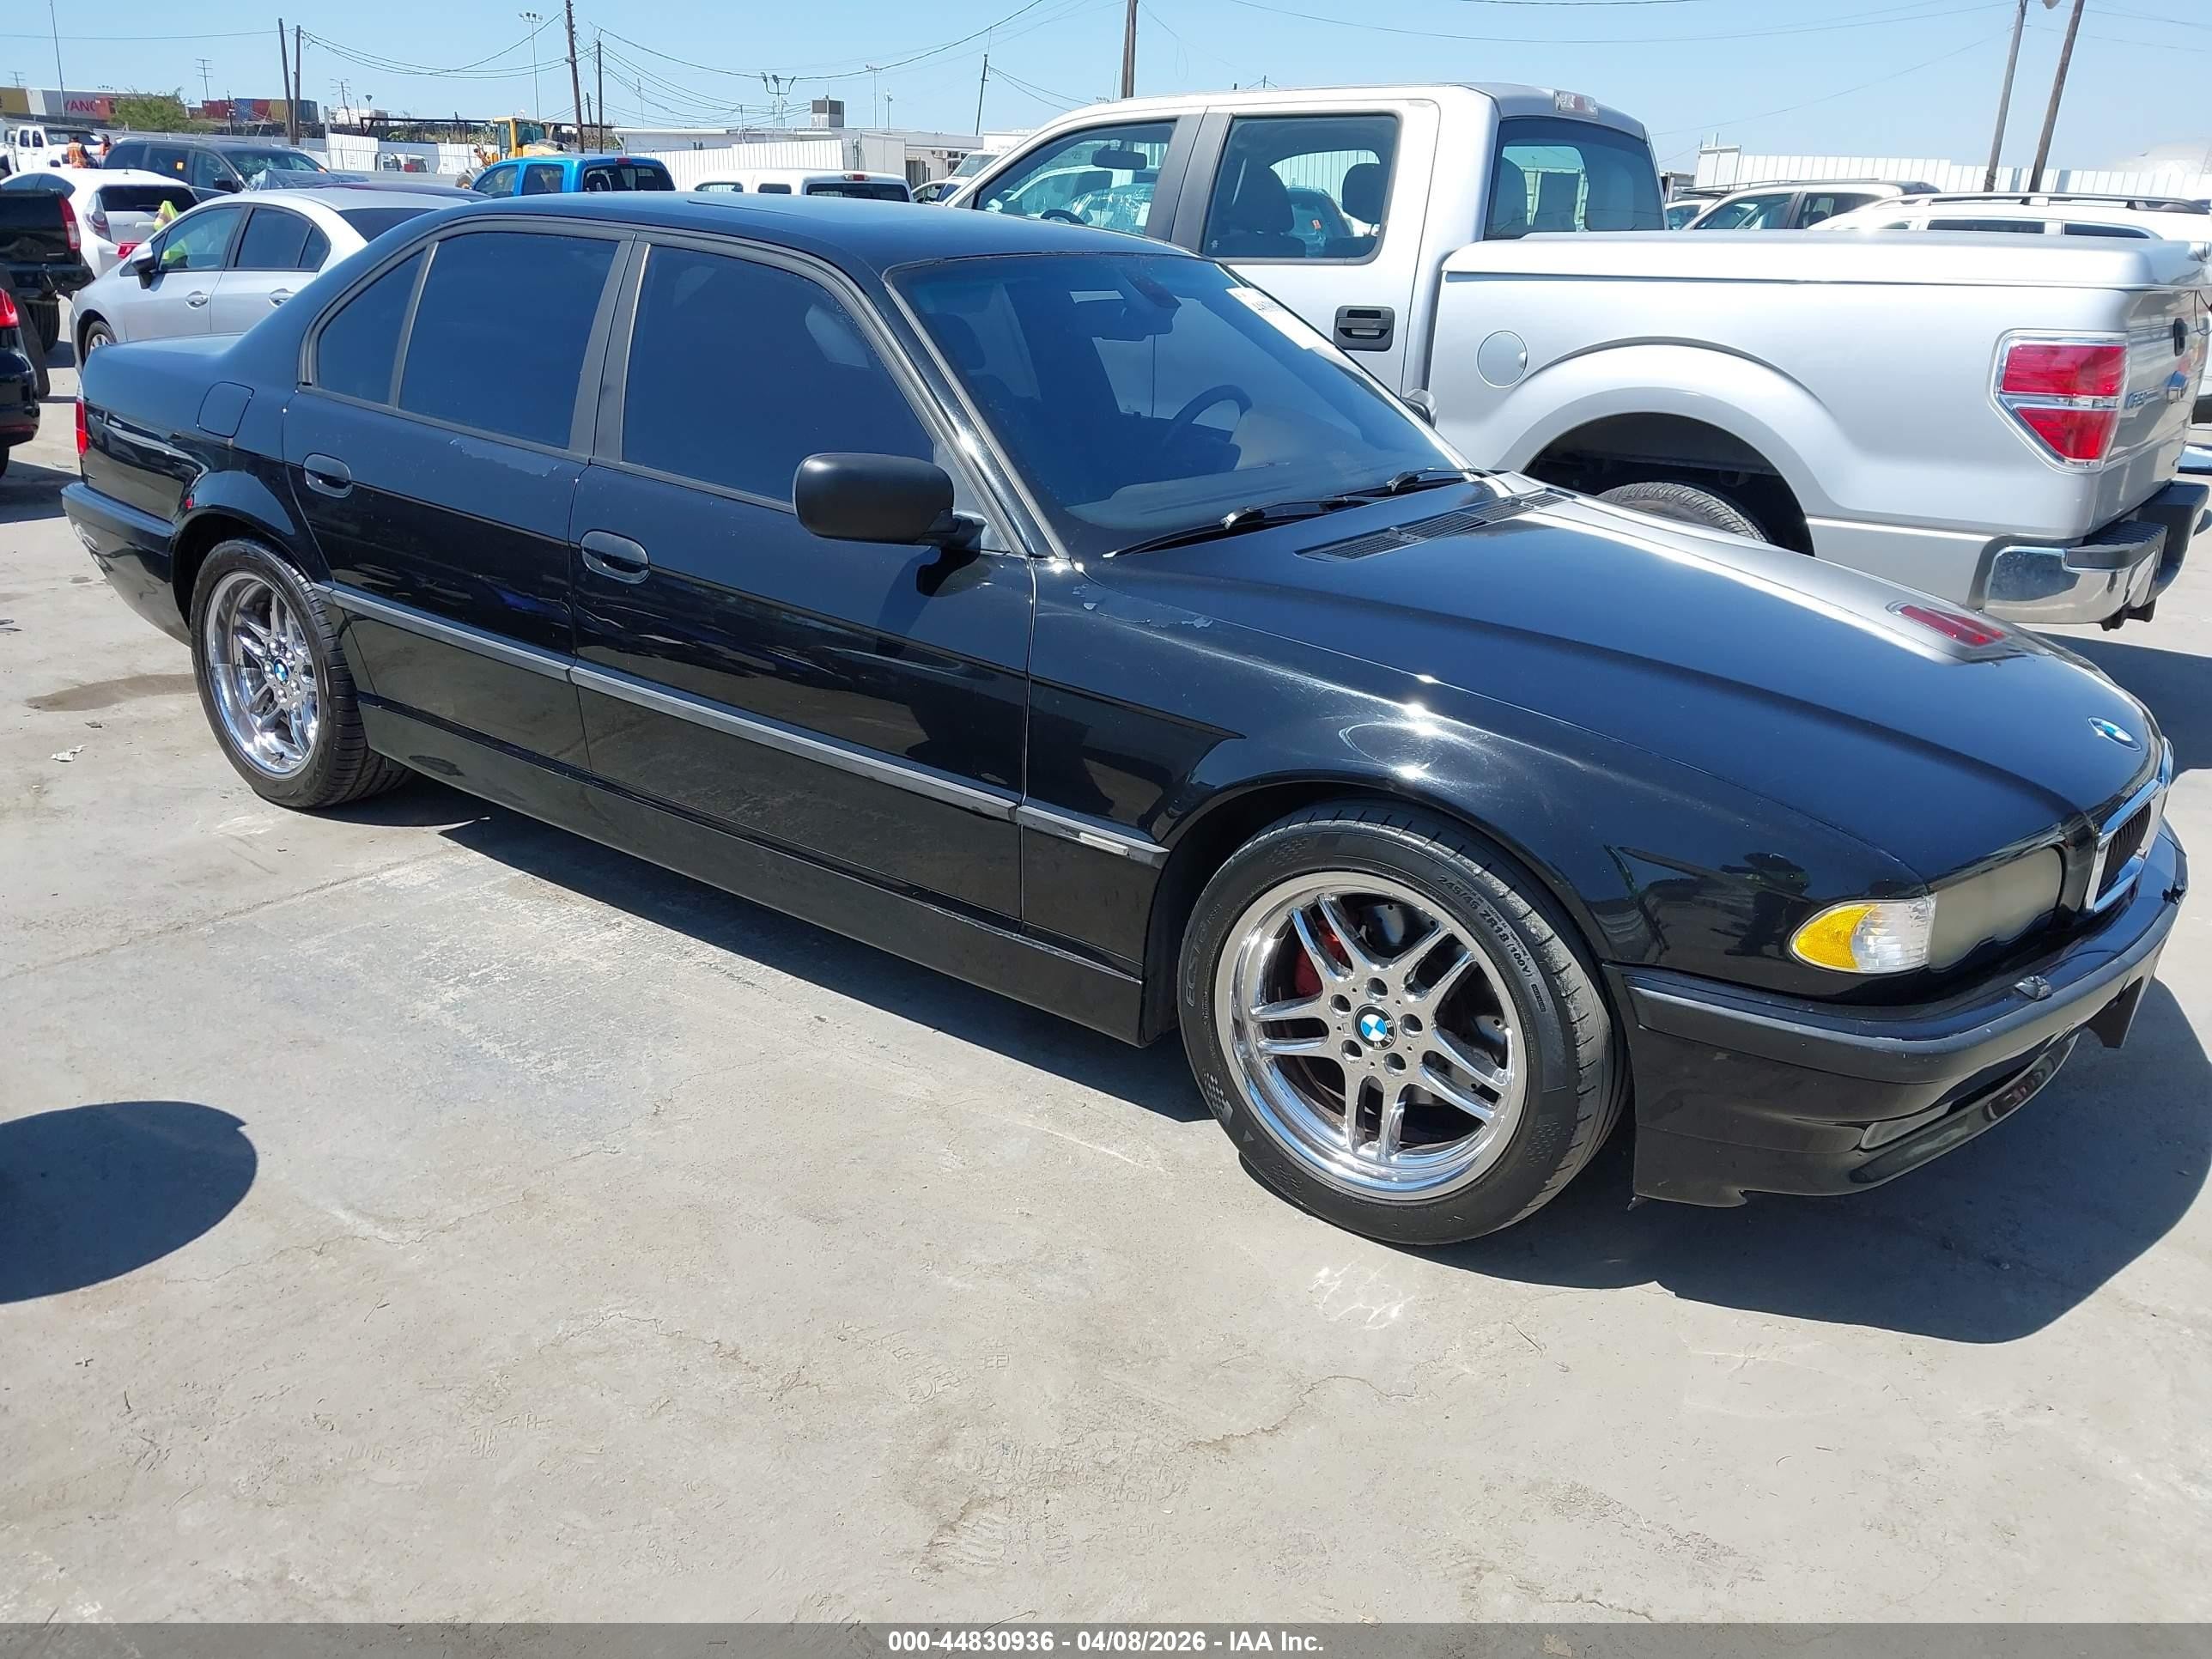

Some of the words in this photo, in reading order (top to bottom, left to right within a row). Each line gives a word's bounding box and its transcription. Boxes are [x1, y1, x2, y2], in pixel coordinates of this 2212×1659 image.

[1437, 874, 1480, 910] 245/45
[1479, 909, 1510, 944] ZR18
[1374, 1019, 1394, 1049] BMW
